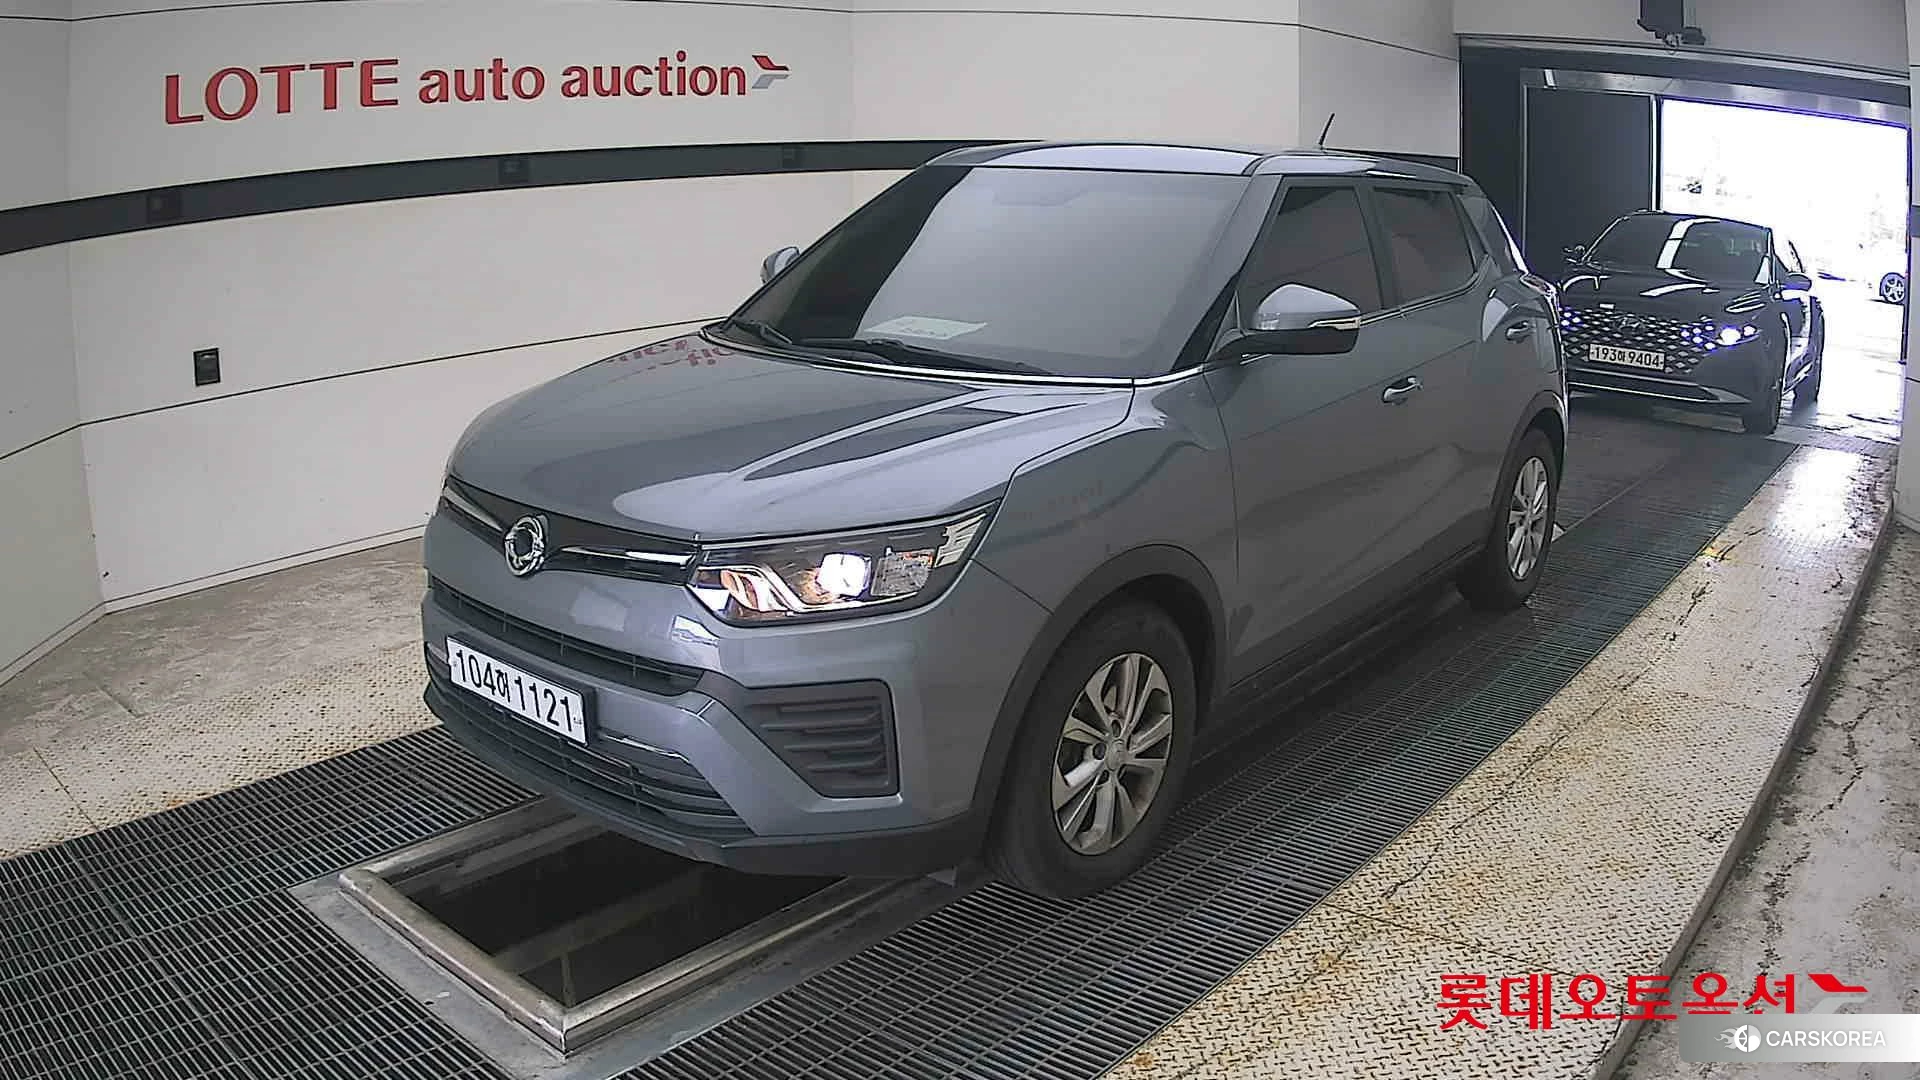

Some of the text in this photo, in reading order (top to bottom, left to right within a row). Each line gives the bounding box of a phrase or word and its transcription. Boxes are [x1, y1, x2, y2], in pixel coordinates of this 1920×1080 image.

[165, 49, 748, 125] LOTTE auto auction
